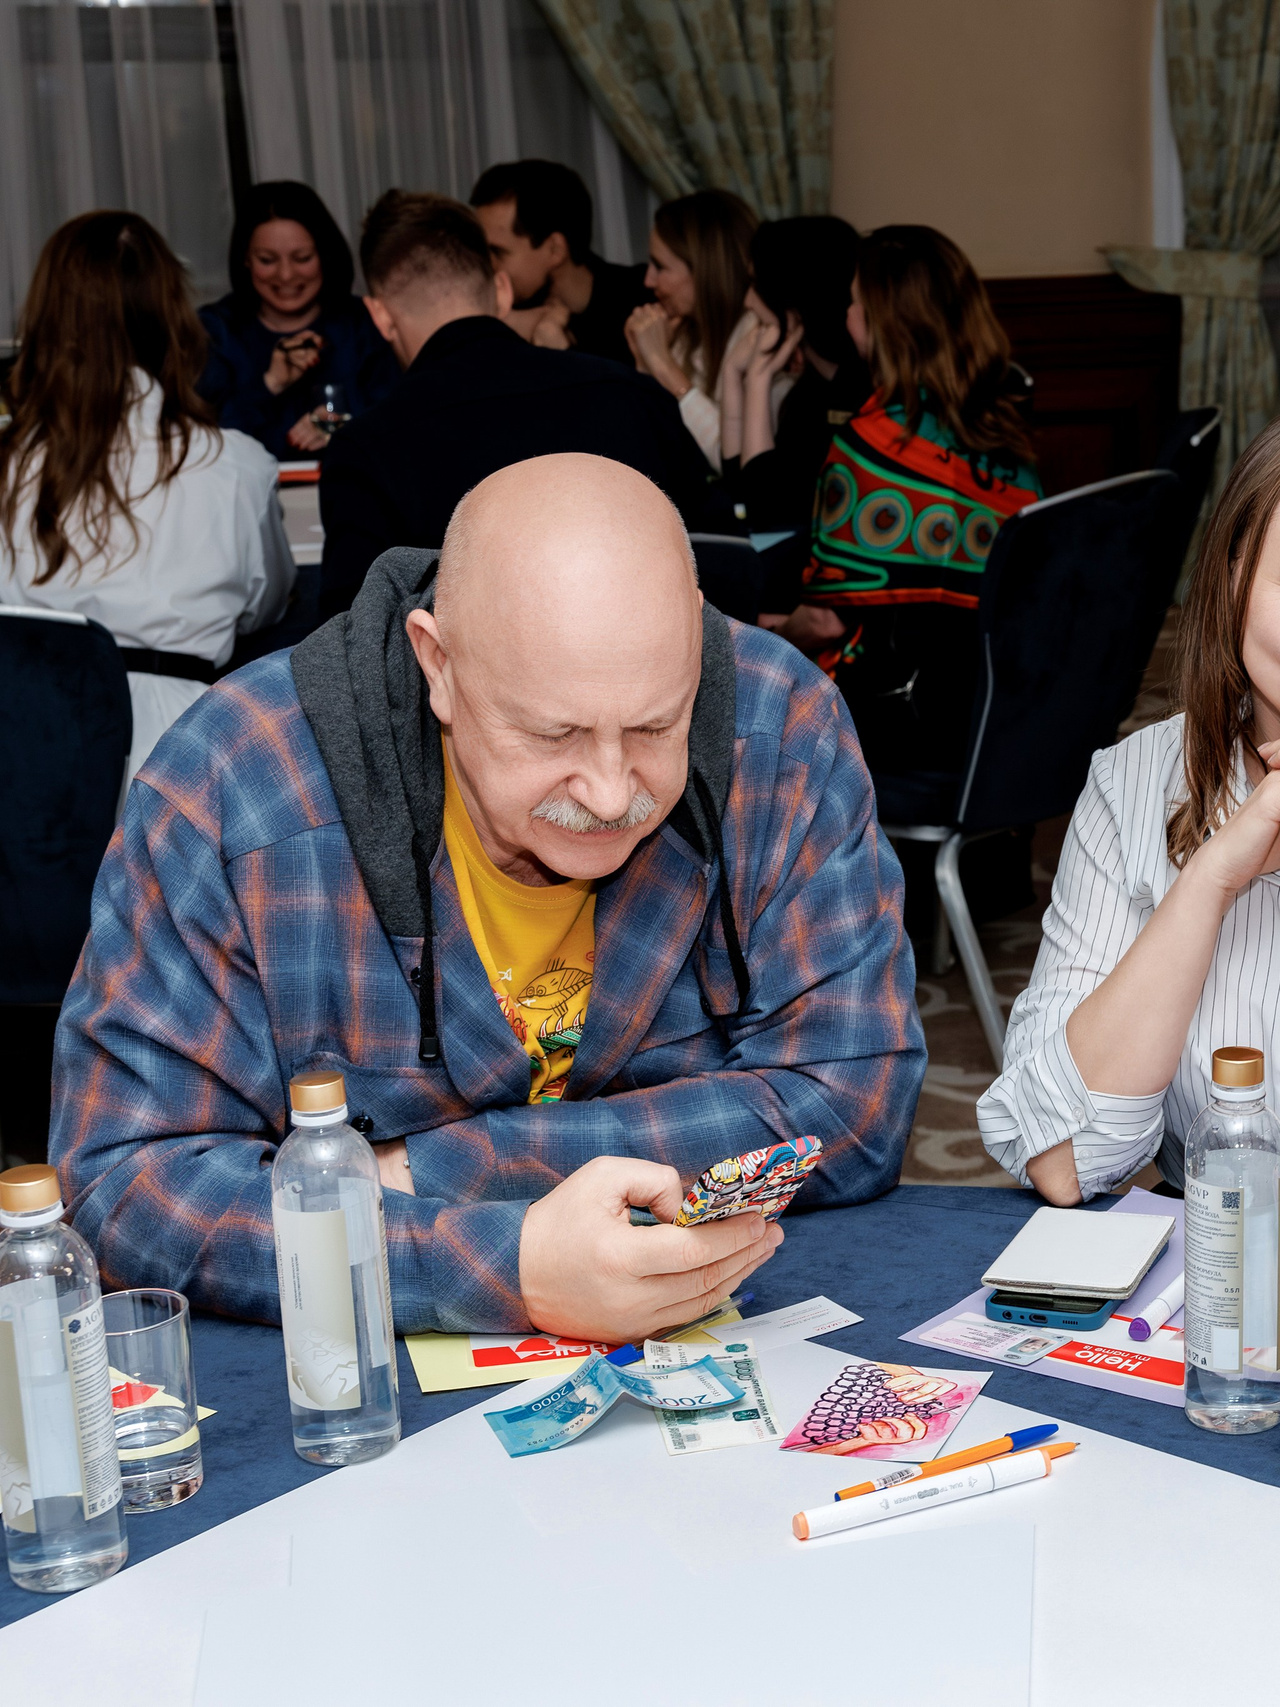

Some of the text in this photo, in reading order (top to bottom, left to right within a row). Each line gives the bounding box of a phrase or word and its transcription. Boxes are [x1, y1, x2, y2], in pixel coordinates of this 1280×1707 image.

[1094, 1347, 1130, 1358] name
[1131, 1354, 1151, 1362] my
[1075, 1350, 1143, 1372] Hello
[531, 1385, 570, 1412] 2000
[647, 1393, 712, 1407] 2000
